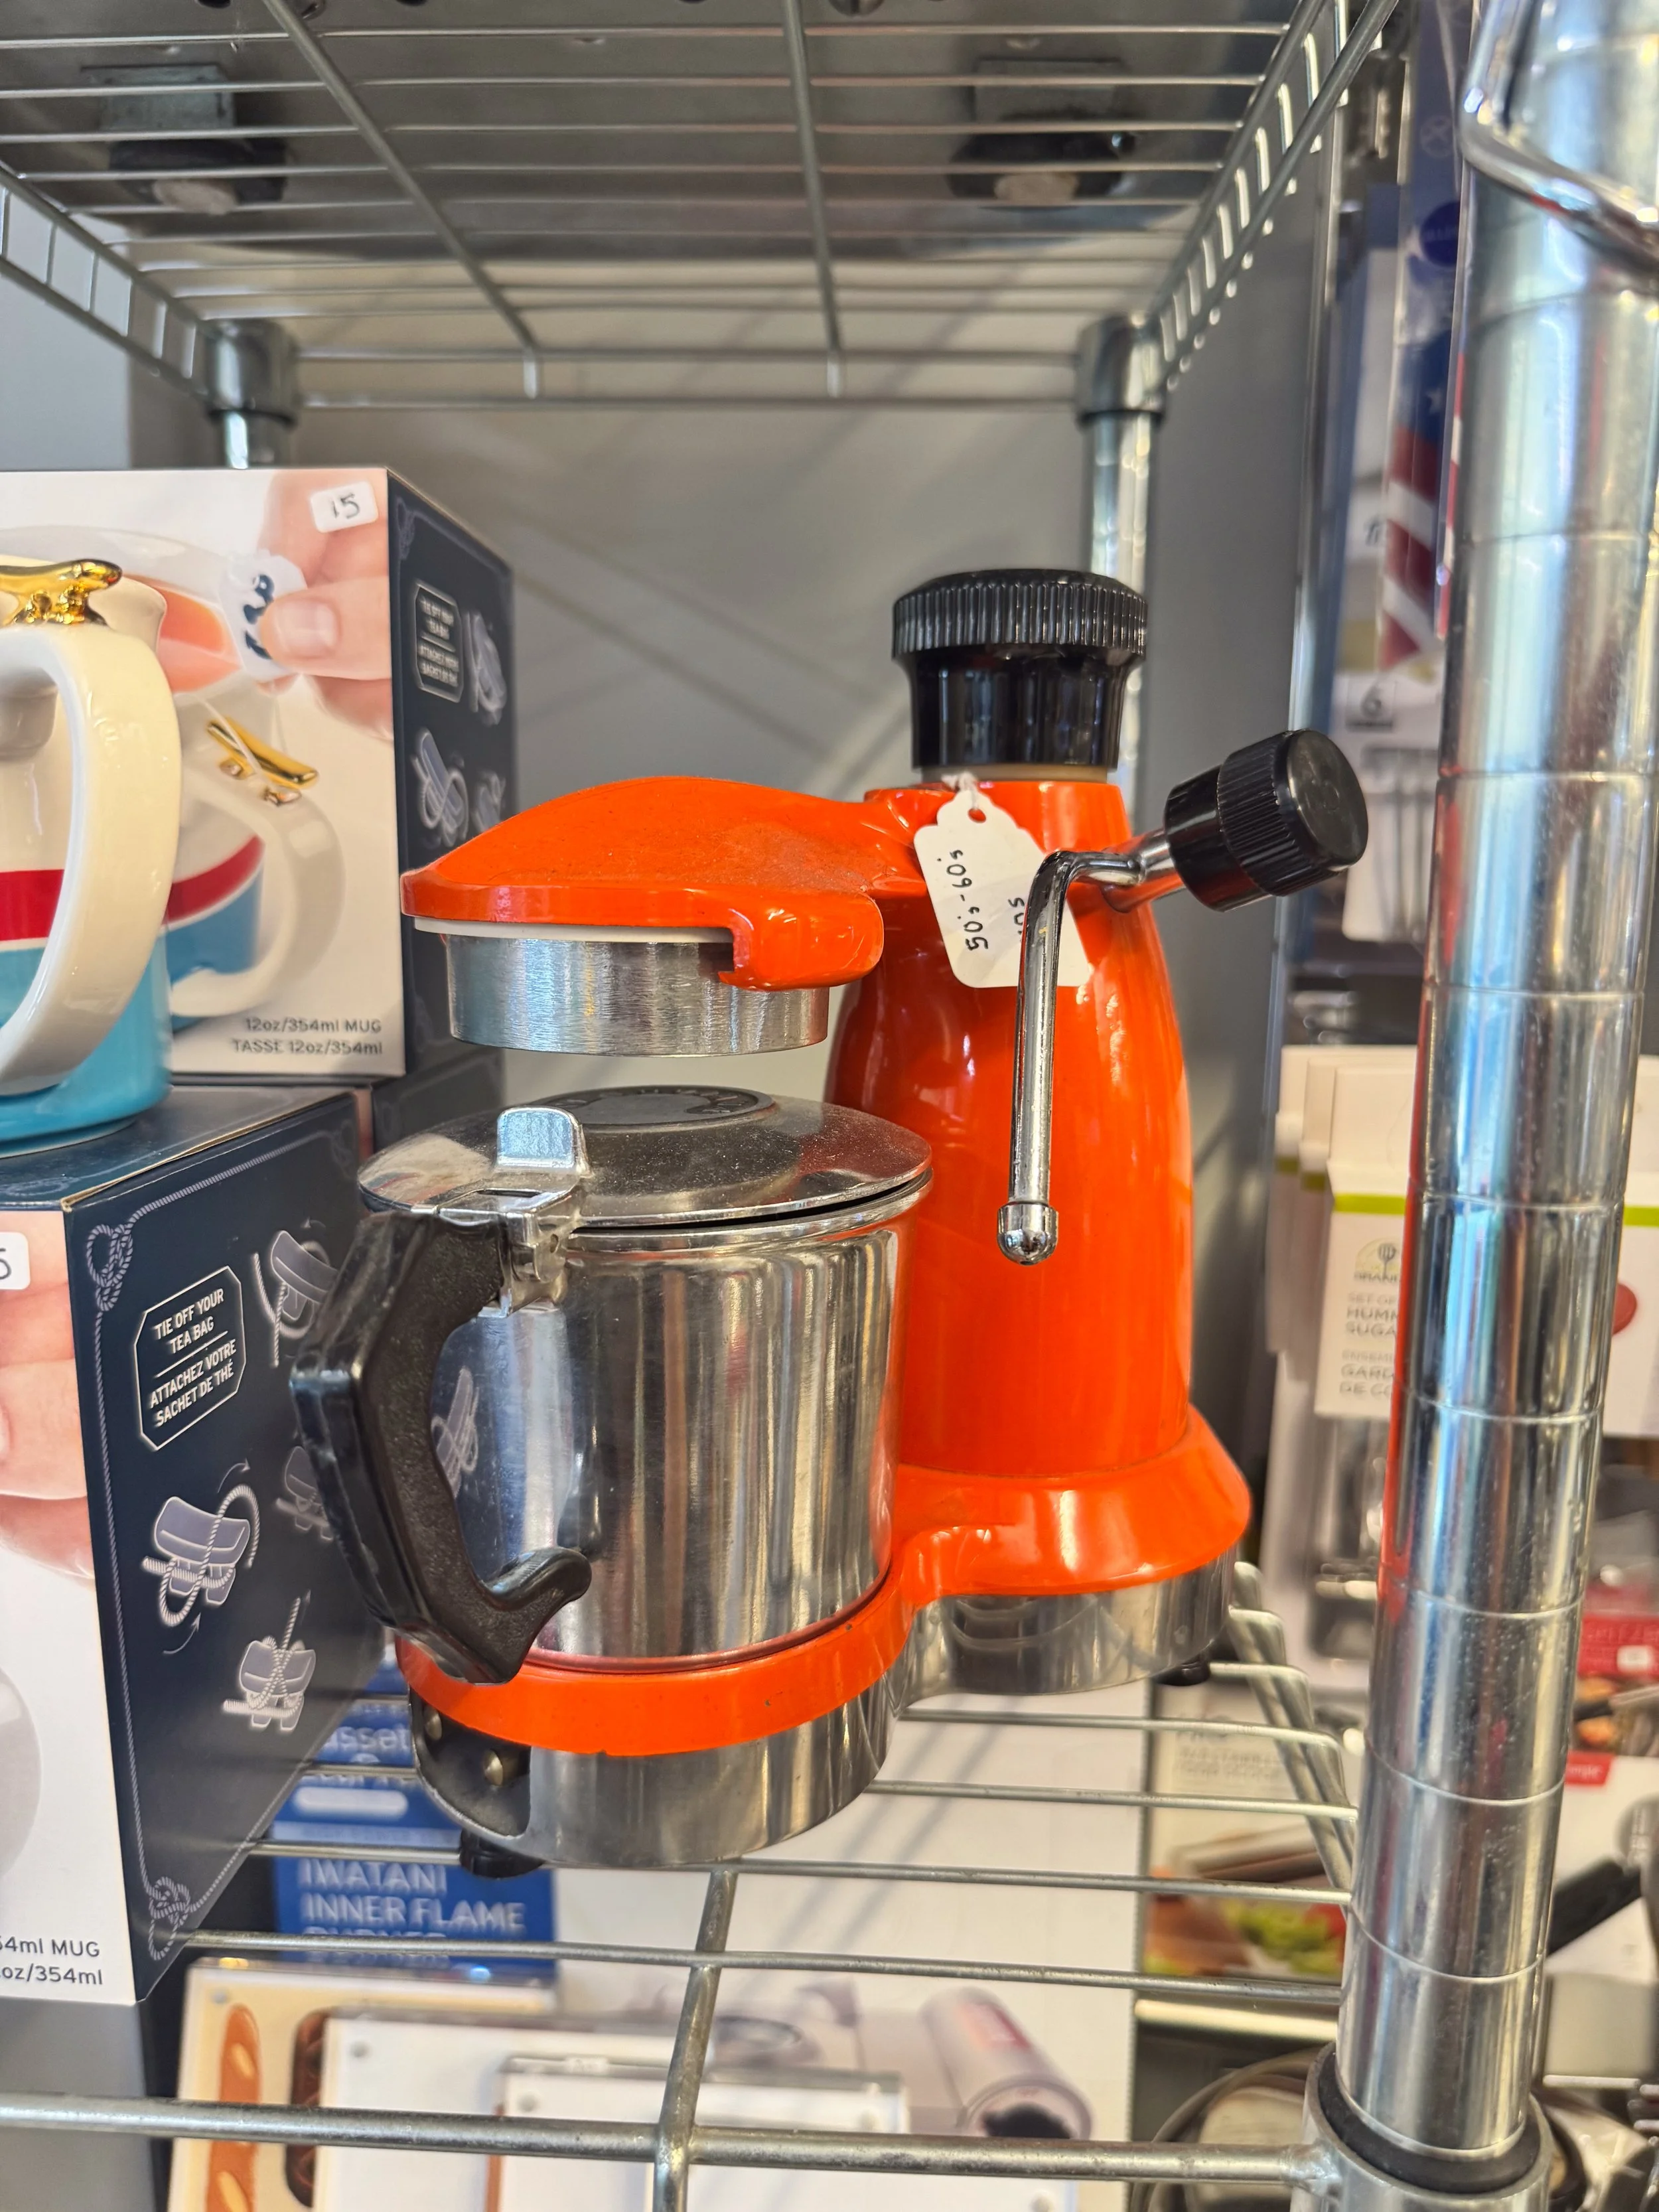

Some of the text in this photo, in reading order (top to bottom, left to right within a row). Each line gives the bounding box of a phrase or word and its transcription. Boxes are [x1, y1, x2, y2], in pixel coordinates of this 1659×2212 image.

[332, 492, 360, 519] 15
[246, 1016, 382, 1033] 12oz/354ml MUG
[233, 1038, 384, 1055] TASSE 12oz/354ml
[154, 1288, 224, 1340] TIE OFF YOUR
[168, 1315, 214, 1354] TEA BAG
[150, 1339, 237, 1409] ATTACHEZ VOTRE
[155, 1359, 234, 1428] SACHET DE THÉ
[298, 1858, 448, 1896] IWATANI
[301, 1893, 526, 1935] INNER FLAME
[0, 1936, 100, 1957] 4ml MUG
[0, 1962, 103, 1985] oz/354ml
